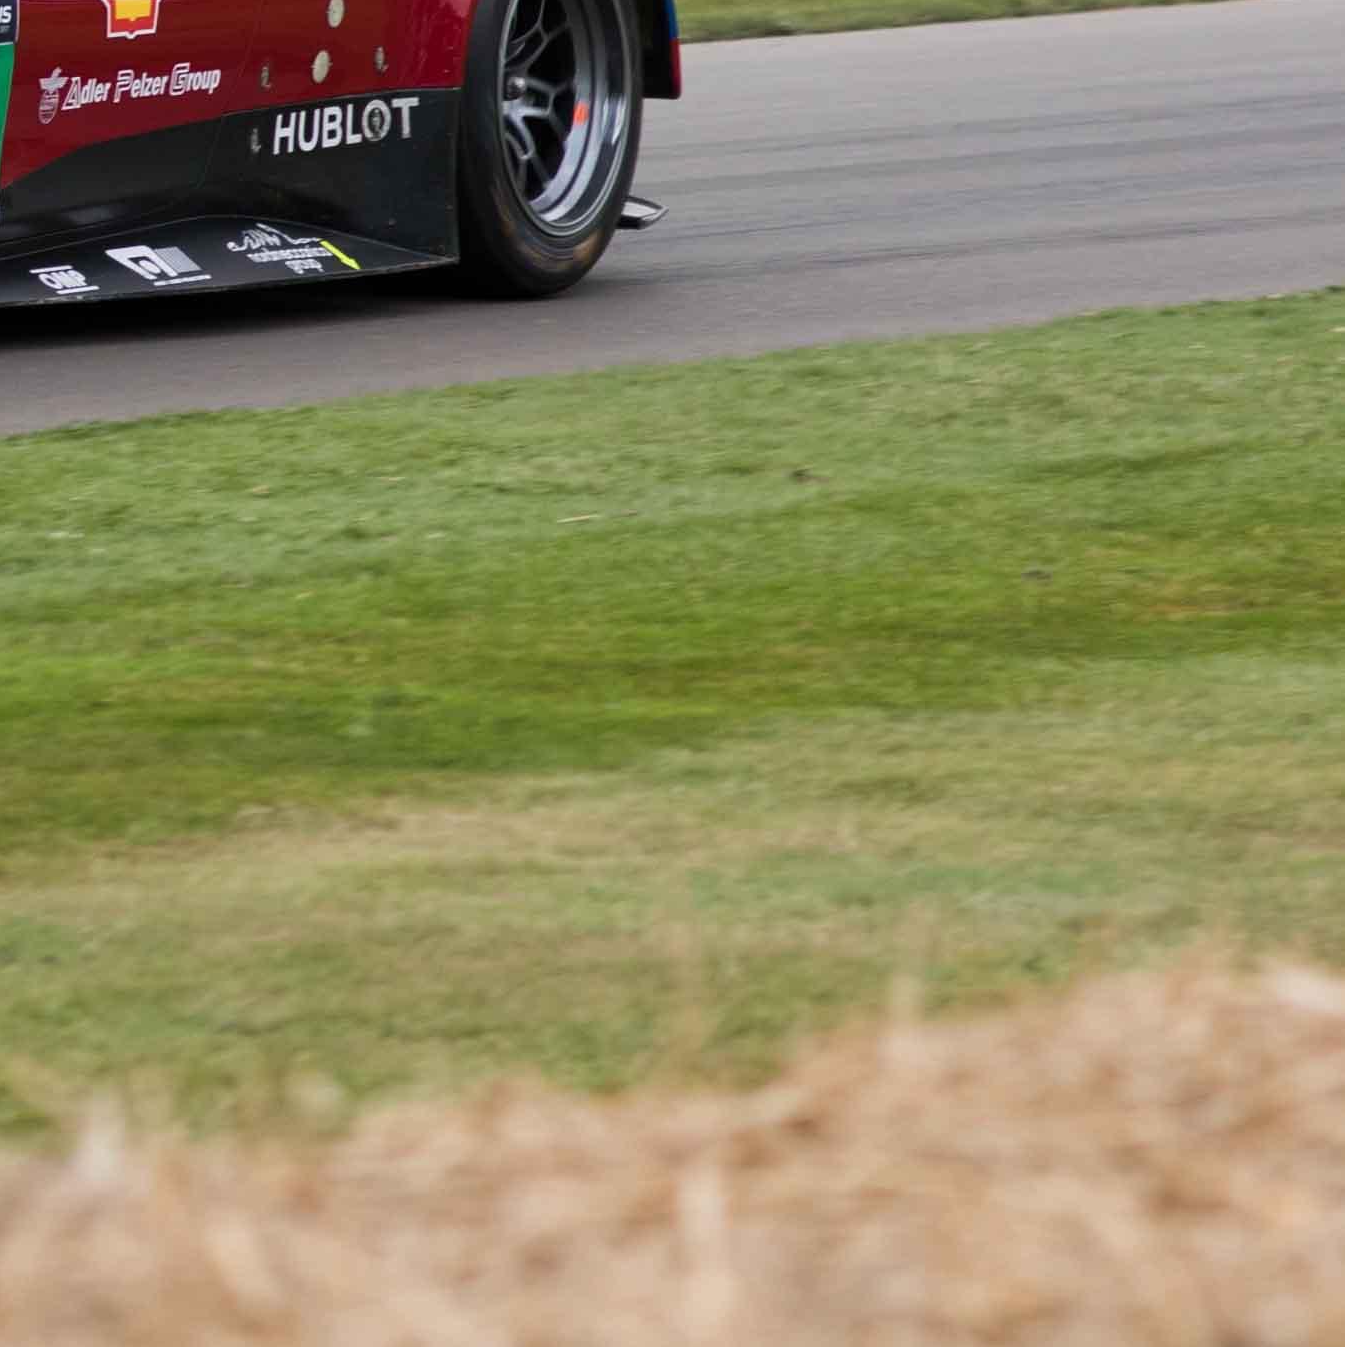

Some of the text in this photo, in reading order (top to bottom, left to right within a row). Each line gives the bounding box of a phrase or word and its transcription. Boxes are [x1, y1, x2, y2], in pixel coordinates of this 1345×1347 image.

[61, 62, 221, 112] Adler Pelzer Group
[273, 96, 421, 156] HUBLOT
